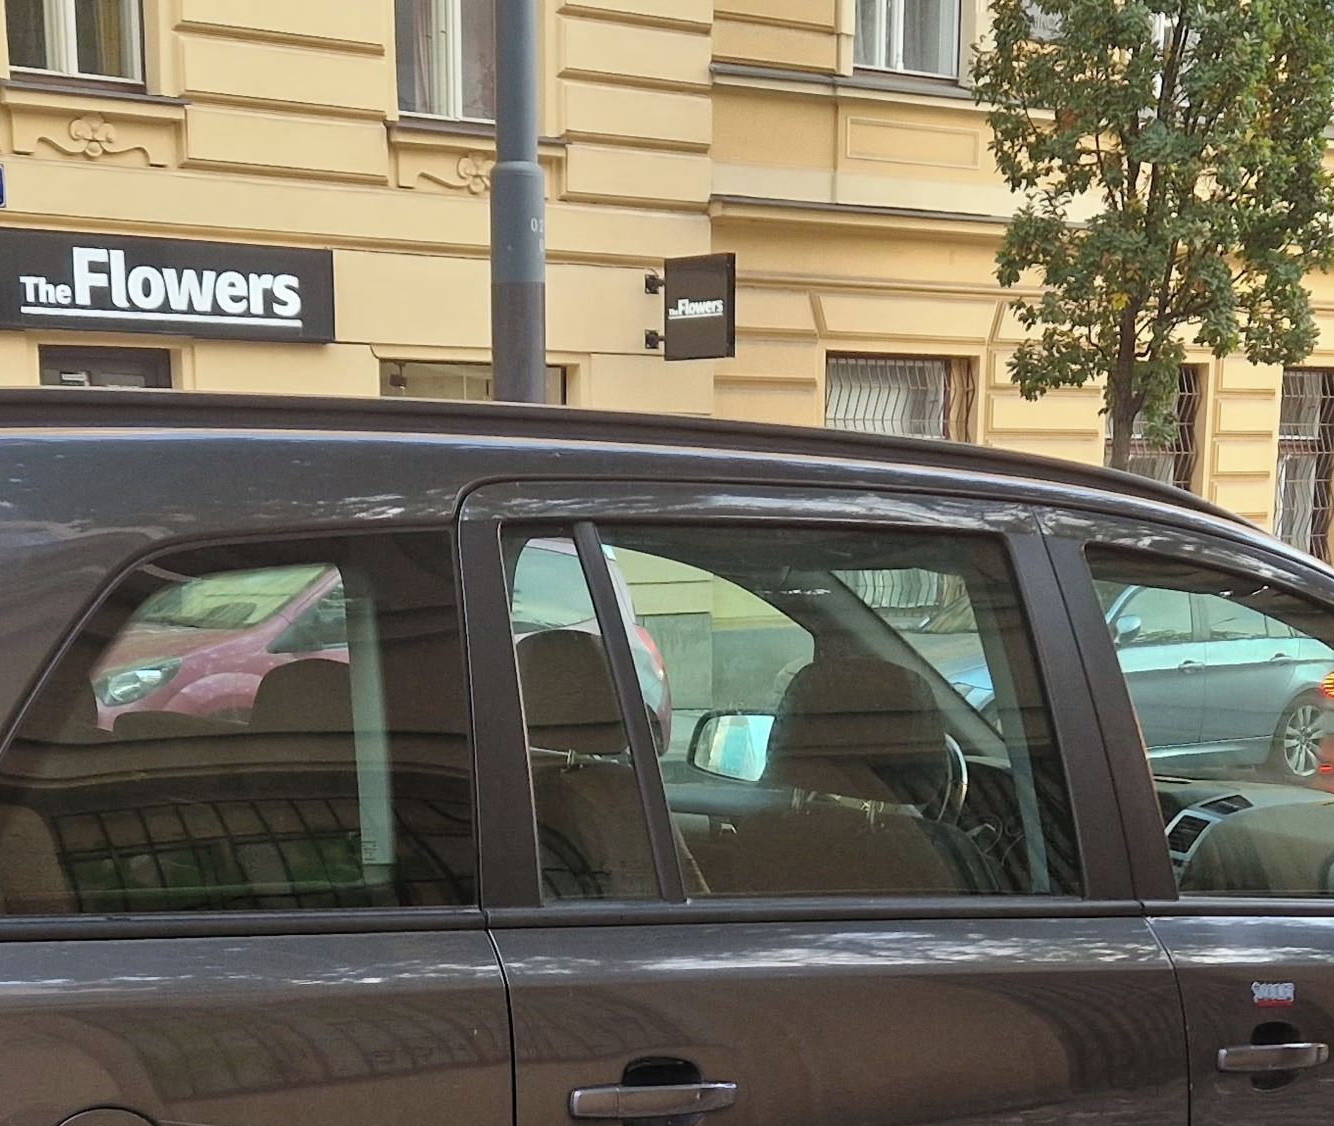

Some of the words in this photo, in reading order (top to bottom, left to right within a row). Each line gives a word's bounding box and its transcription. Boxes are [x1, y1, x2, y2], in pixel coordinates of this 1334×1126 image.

[19, 276, 72, 305] The
[72, 247, 302, 317] Flowers
[678, 298, 724, 315] Flowers
